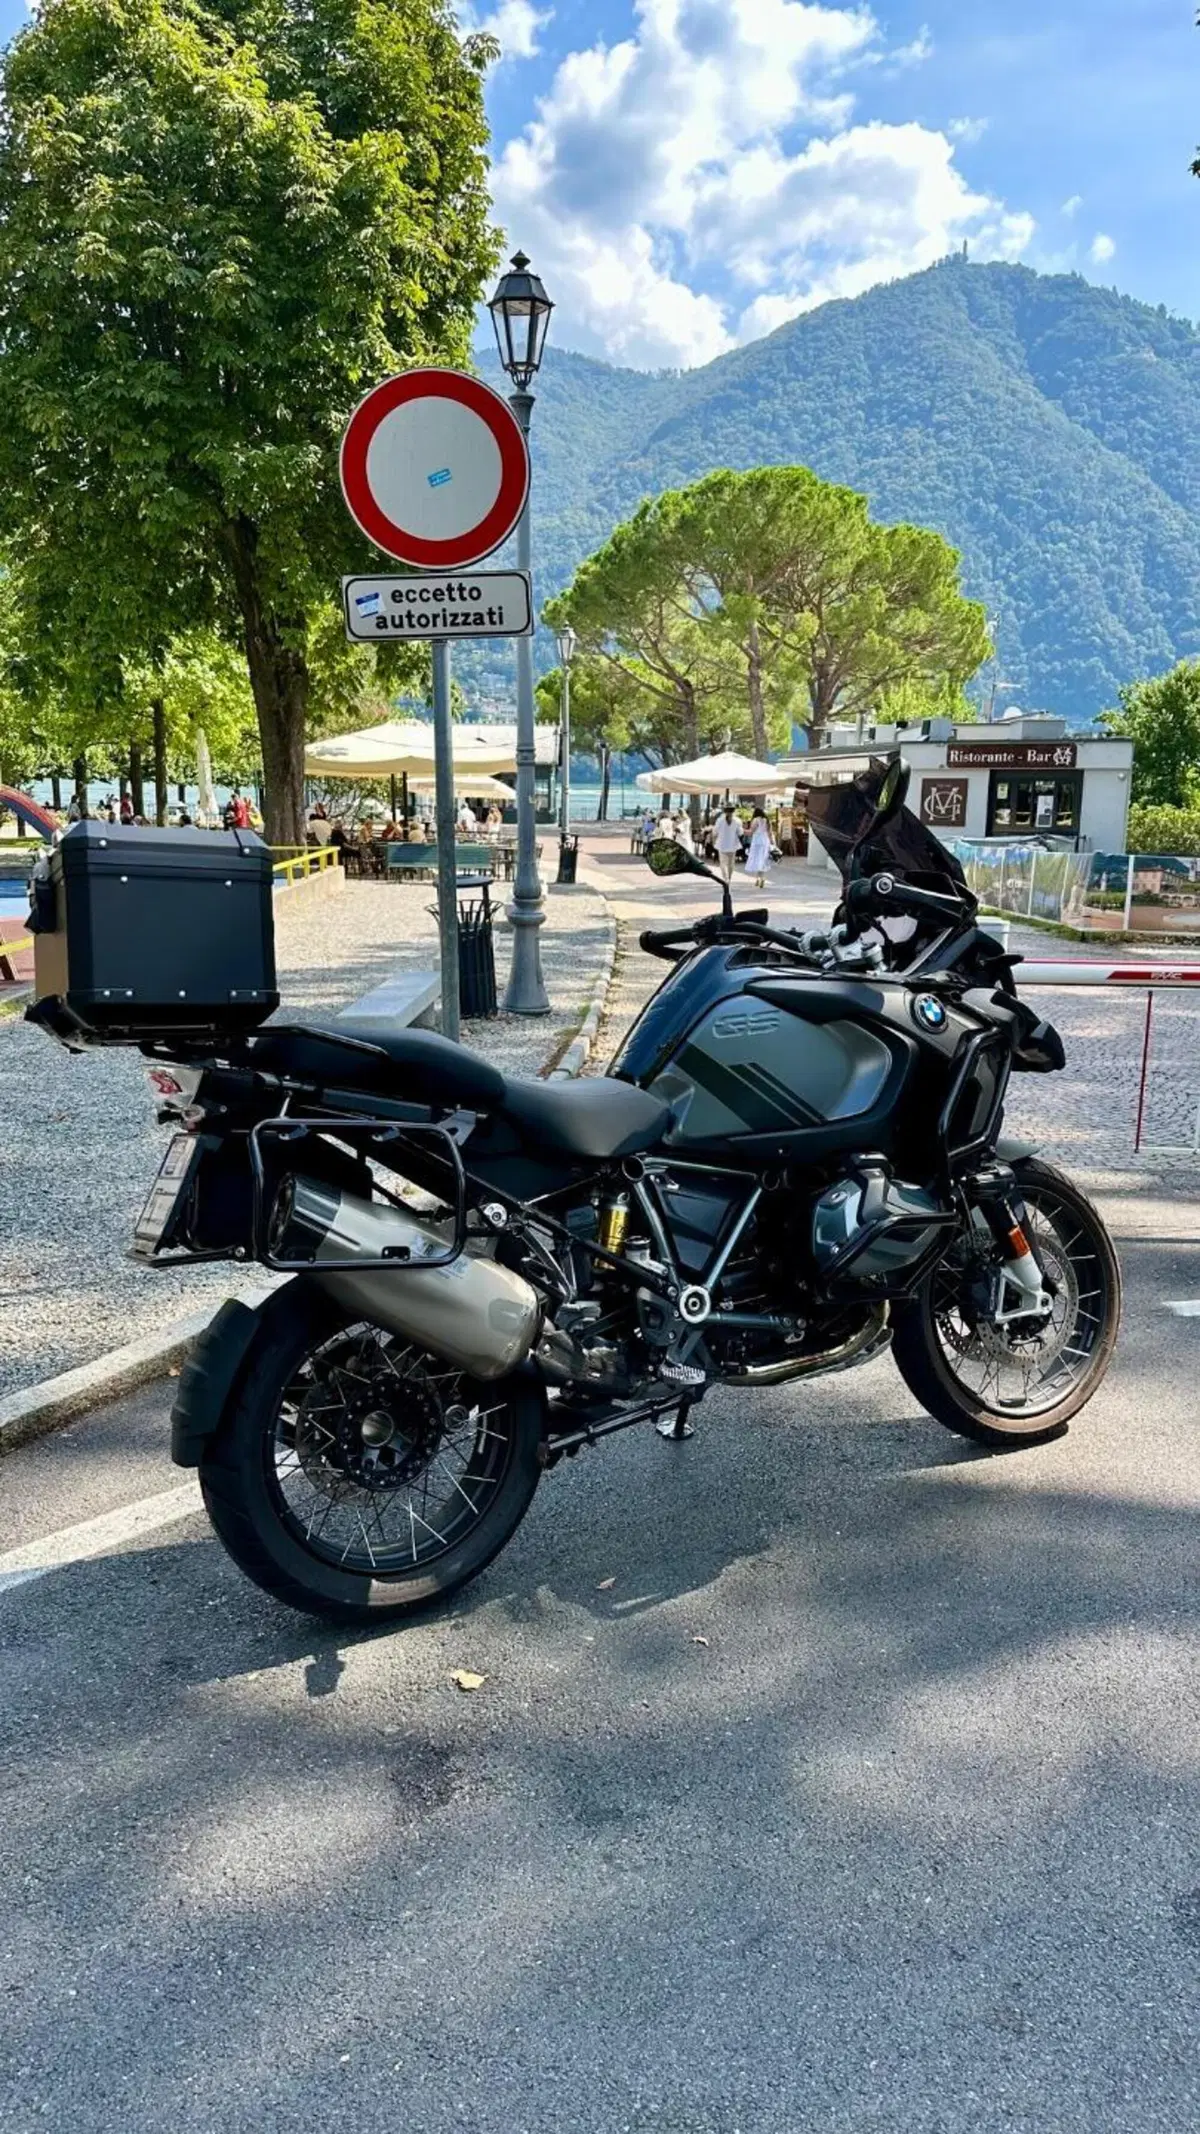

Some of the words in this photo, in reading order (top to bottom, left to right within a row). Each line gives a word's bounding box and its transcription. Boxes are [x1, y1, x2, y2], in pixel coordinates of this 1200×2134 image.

[391, 583, 482, 603] eccetto
[376, 607, 504, 630] autorizzati
[950, 750, 1015, 763] Ristorante
[1027, 749, 1051, 763] Bar
[712, 1010, 780, 1039] GS
